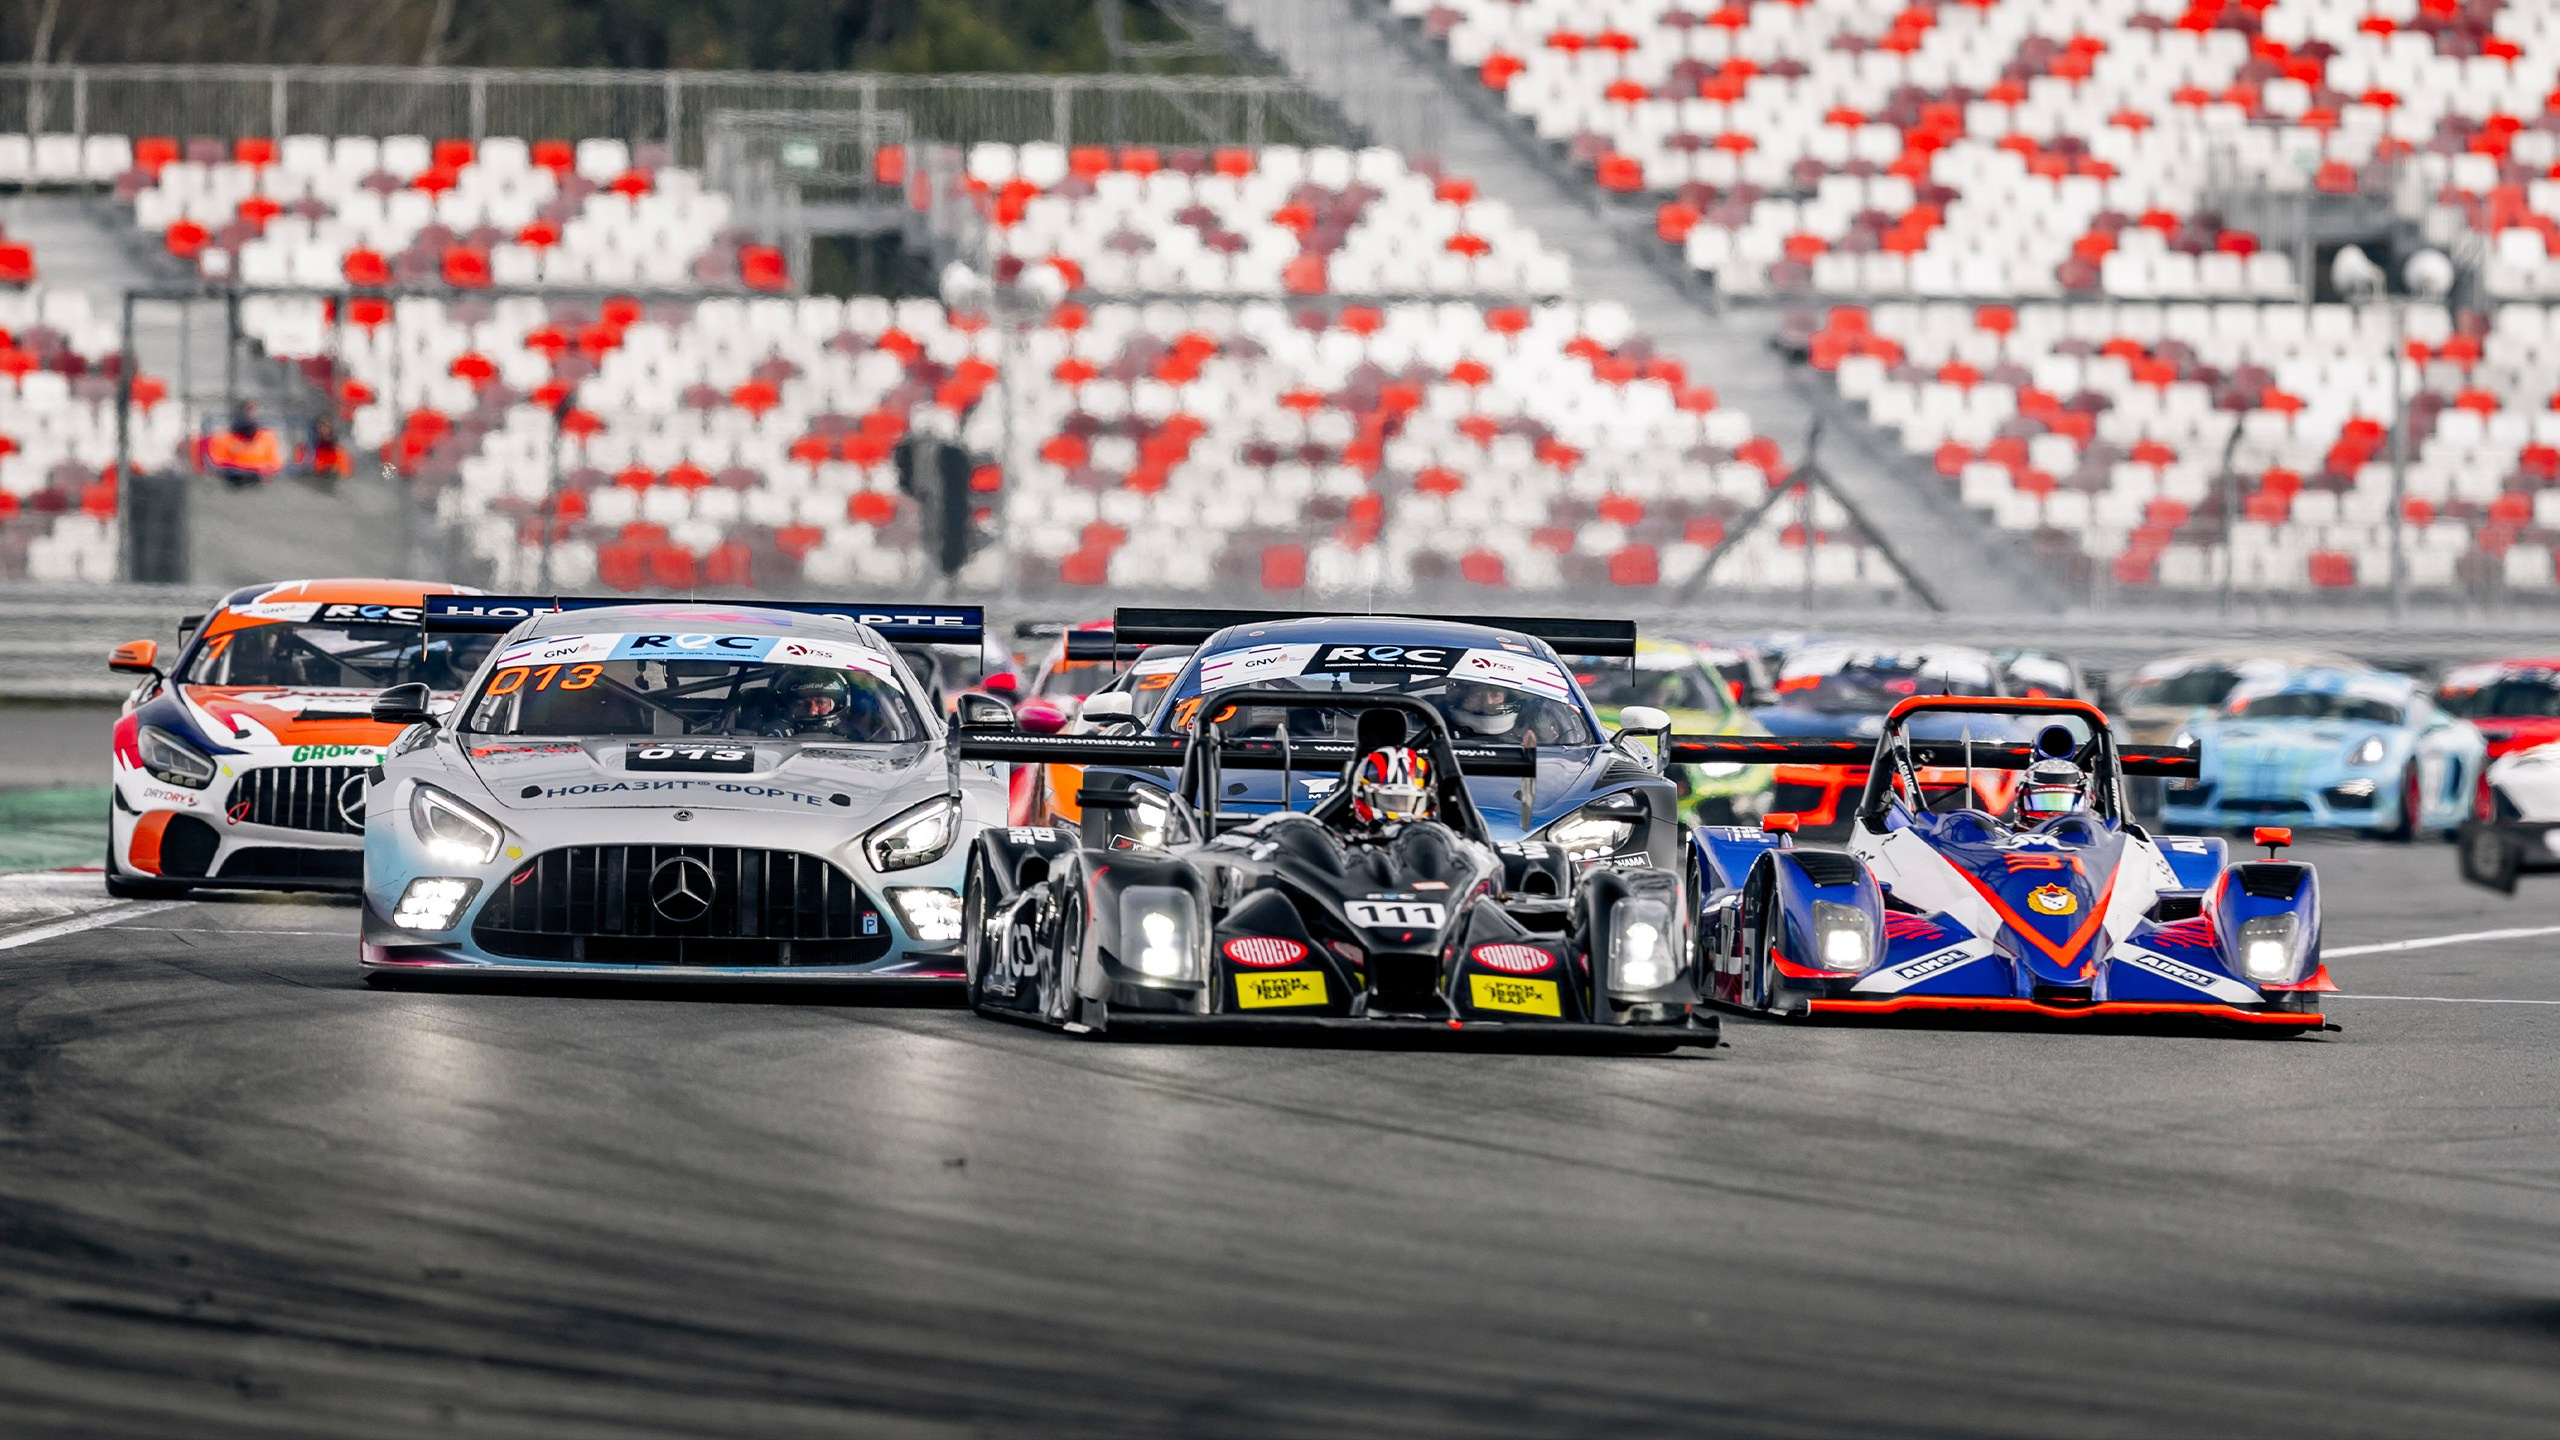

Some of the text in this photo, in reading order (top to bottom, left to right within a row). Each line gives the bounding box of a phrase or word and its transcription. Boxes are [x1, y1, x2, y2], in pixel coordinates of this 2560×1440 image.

[207, 632, 236, 661] 1
[543, 646, 580, 659] GNV
[808, 648, 833, 659] TSS
[1244, 656, 1278, 669] GNV
[1491, 661, 1515, 672] TSS
[485, 663, 605, 697] 013
[972, 734, 1156, 747] www.transpromstroy.ru
[638, 748, 747, 761] 013
[715, 783, 823, 807] ФОРТЕ
[2003, 852, 2085, 876] 31
[1357, 905, 1436, 924] 111
